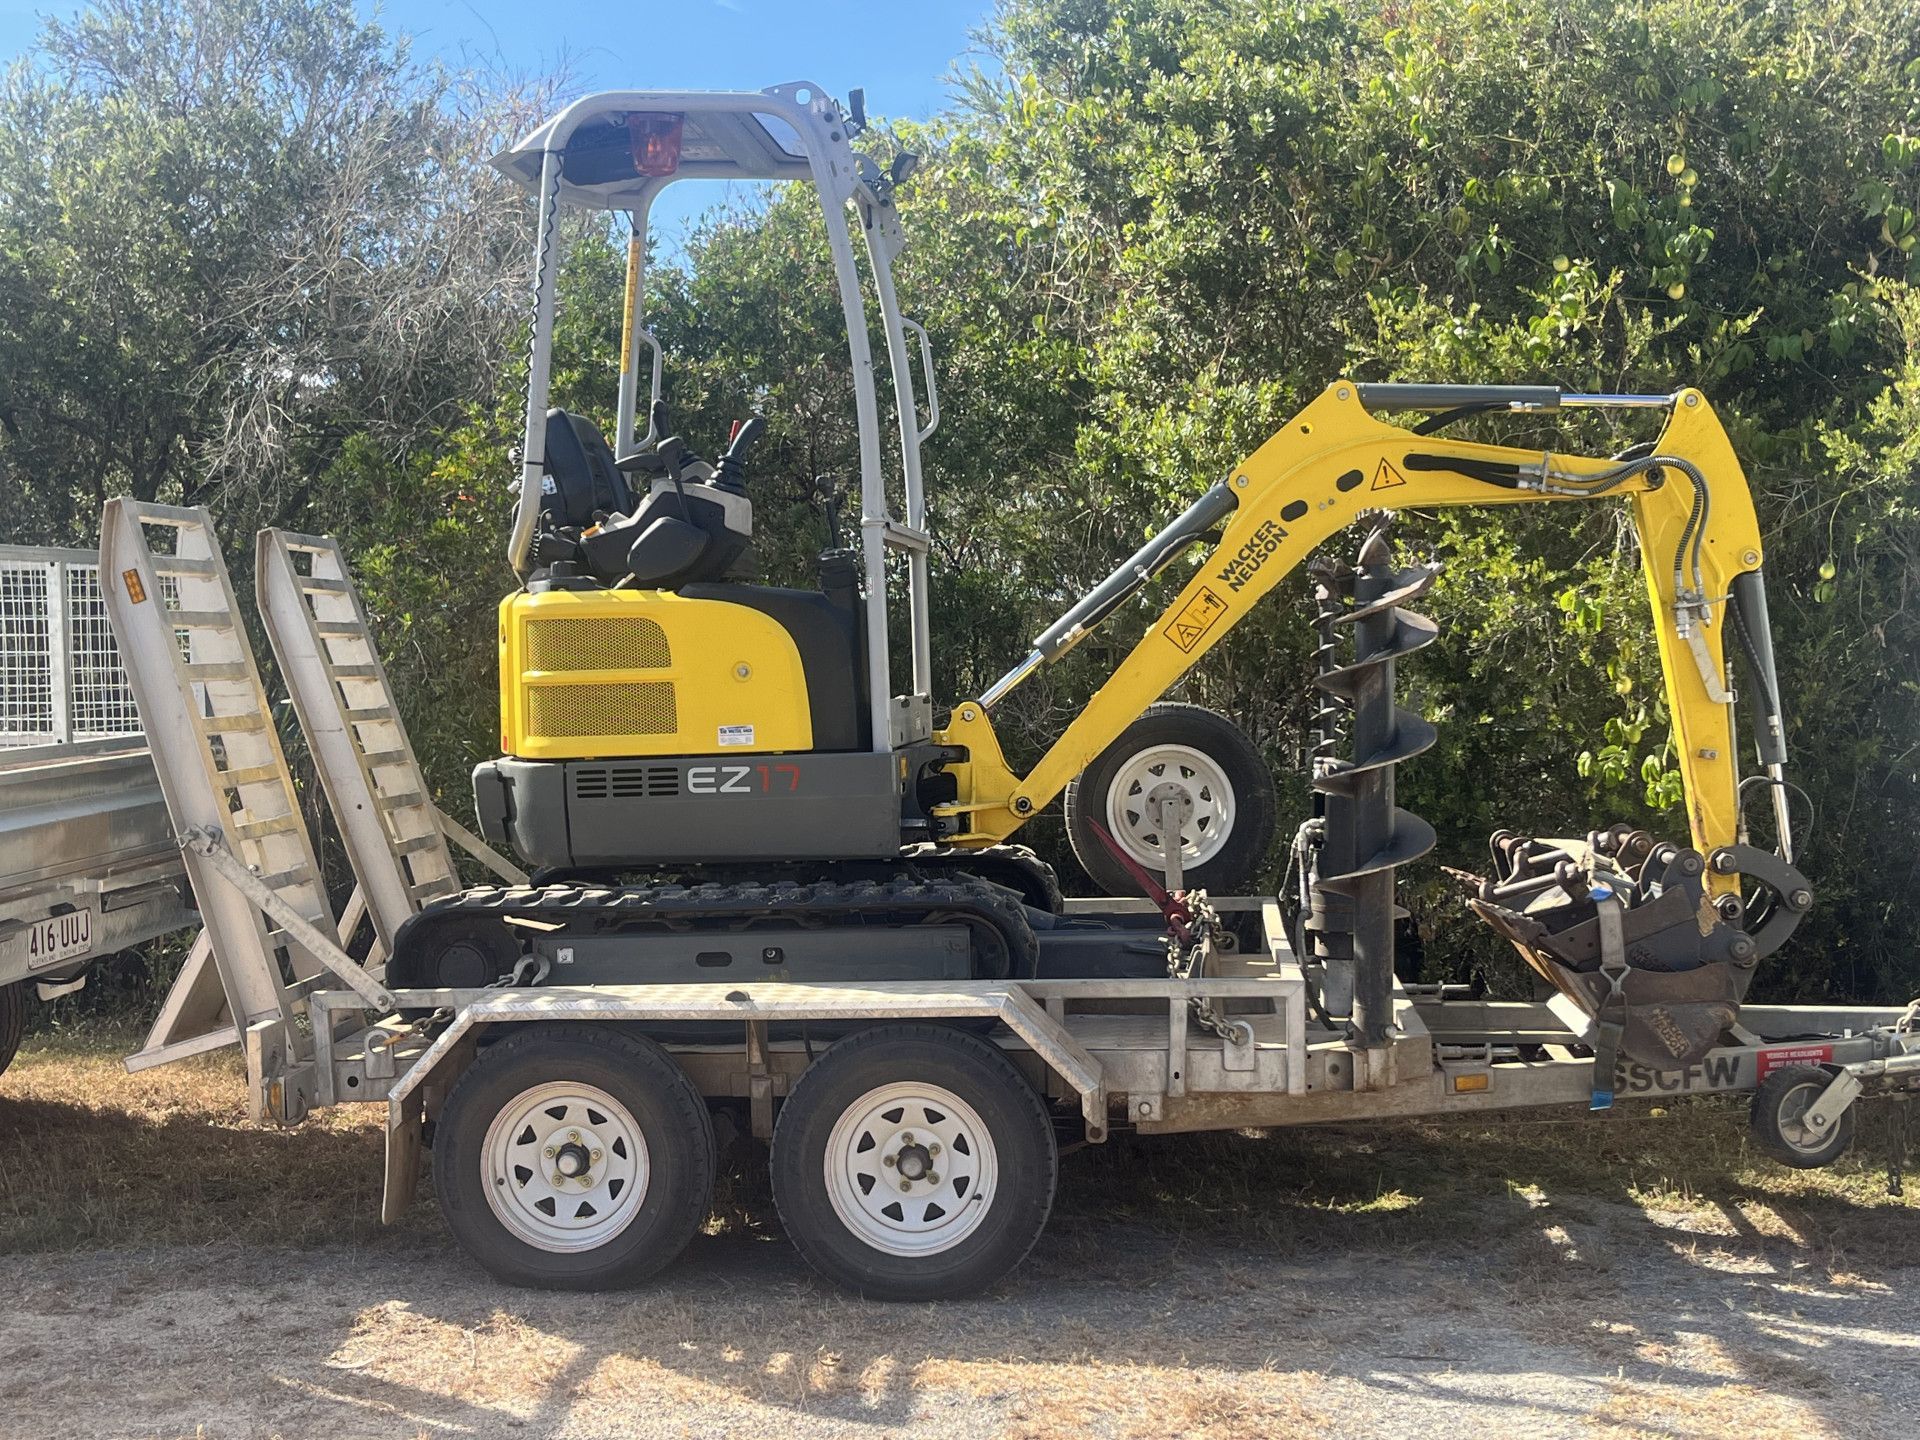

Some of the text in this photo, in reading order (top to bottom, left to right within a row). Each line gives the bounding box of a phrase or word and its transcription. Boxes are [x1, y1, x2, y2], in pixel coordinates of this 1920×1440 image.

[1216, 519, 1278, 582] WACKER
[1228, 526, 1289, 593] NEUSON
[687, 764, 800, 794] EZ17
